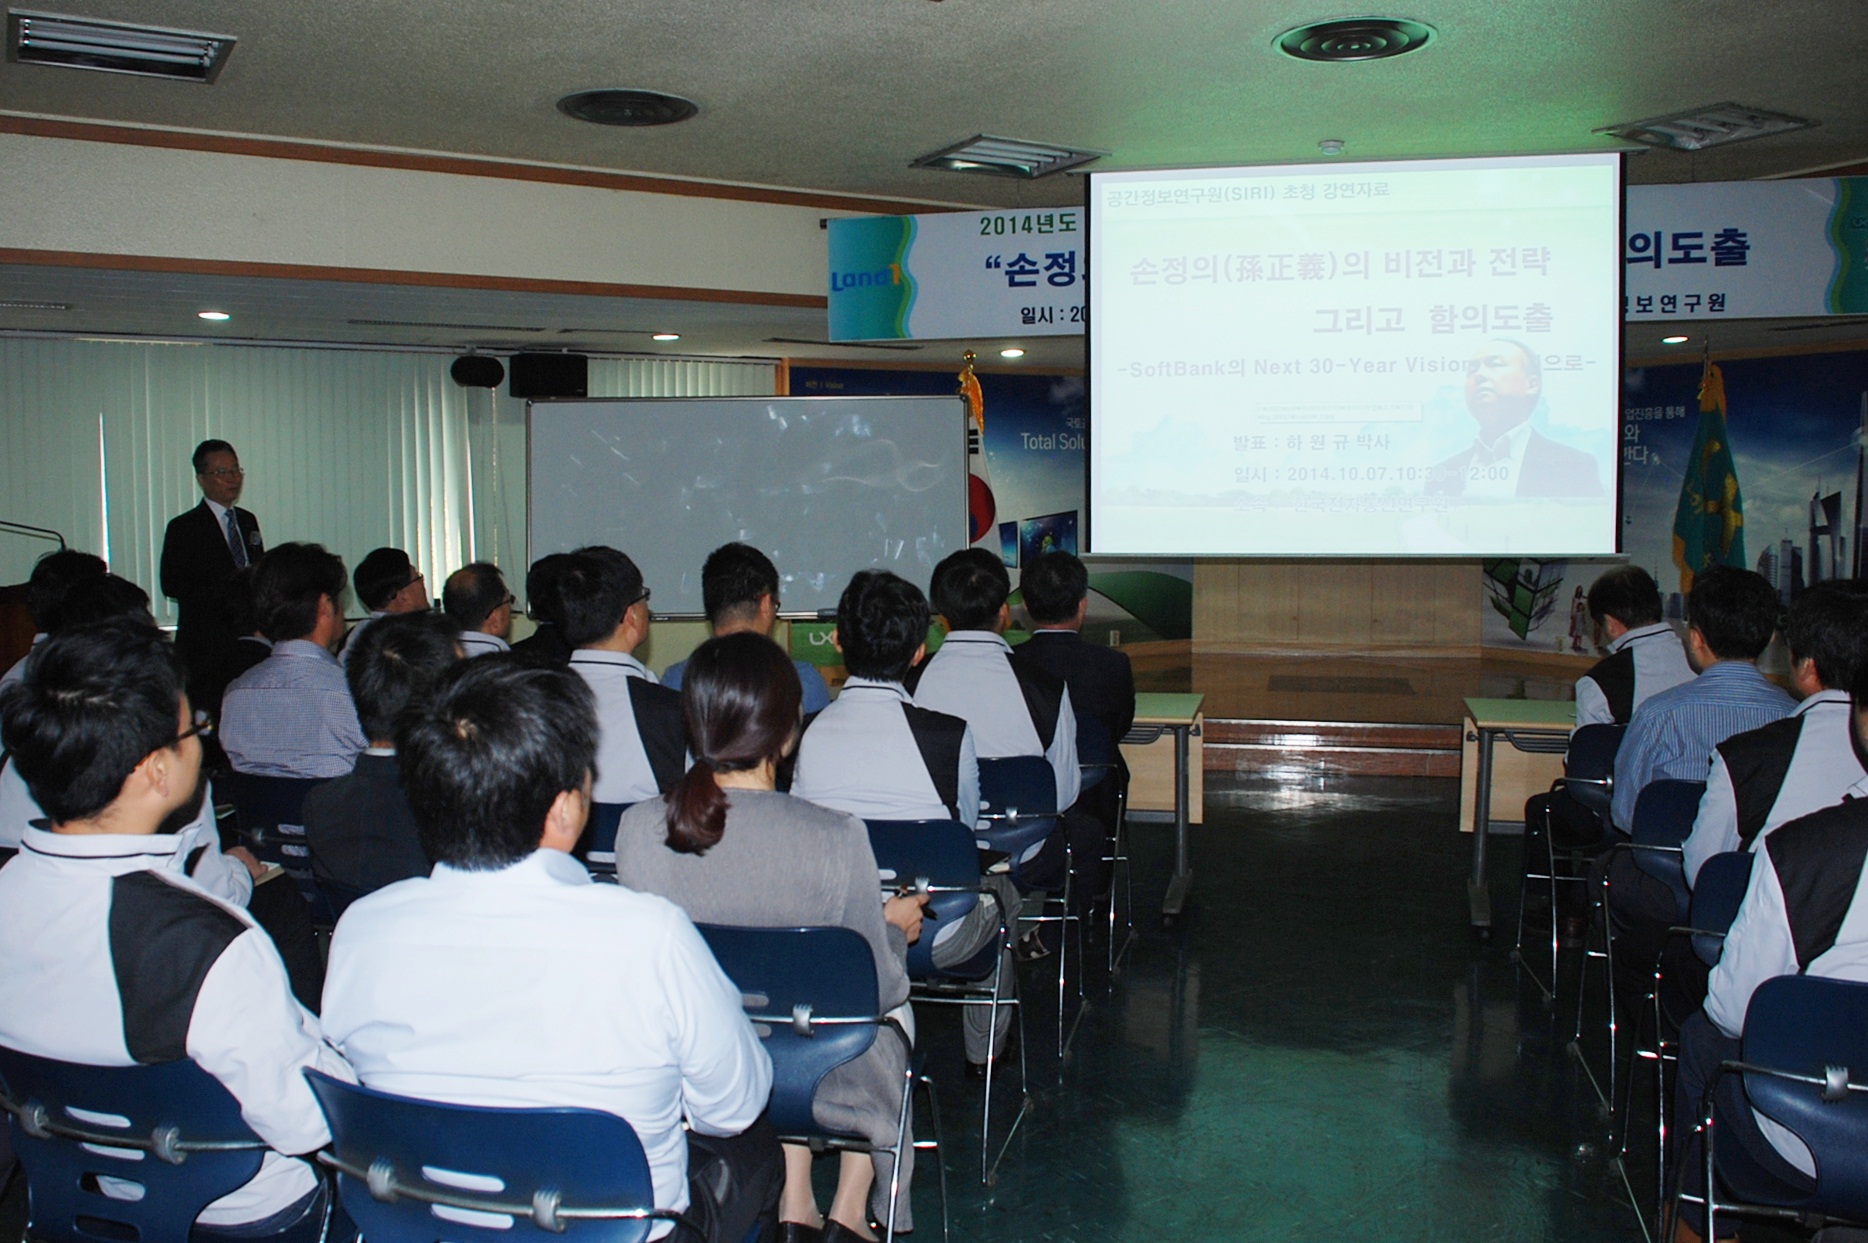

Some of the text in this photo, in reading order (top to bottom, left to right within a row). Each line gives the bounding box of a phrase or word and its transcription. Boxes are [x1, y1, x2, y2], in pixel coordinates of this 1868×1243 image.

[1106, 181, 1391, 208] 공간정보연구원(SIRI) 초청 강연자료
[980, 212, 1077, 236] 2014년도
[985, 250, 1085, 288] “손정
[1130, 246, 1551, 286] 손정의(孫正義)의 비전과 전략
[1020, 306, 1054, 325] 일시
[1313, 302, 1553, 336] 그리고 함의도출
[1117, 358, 1246, 378] -SoftBank의
[1254, 359, 1302, 375] Next
[1309, 357, 1397, 374] 30-Year
[1020, 432, 1056, 450] Total
[1233, 434, 1267, 452] 발표
[1356, 433, 1390, 451] 박사
[1234, 466, 1267, 483] 일시
